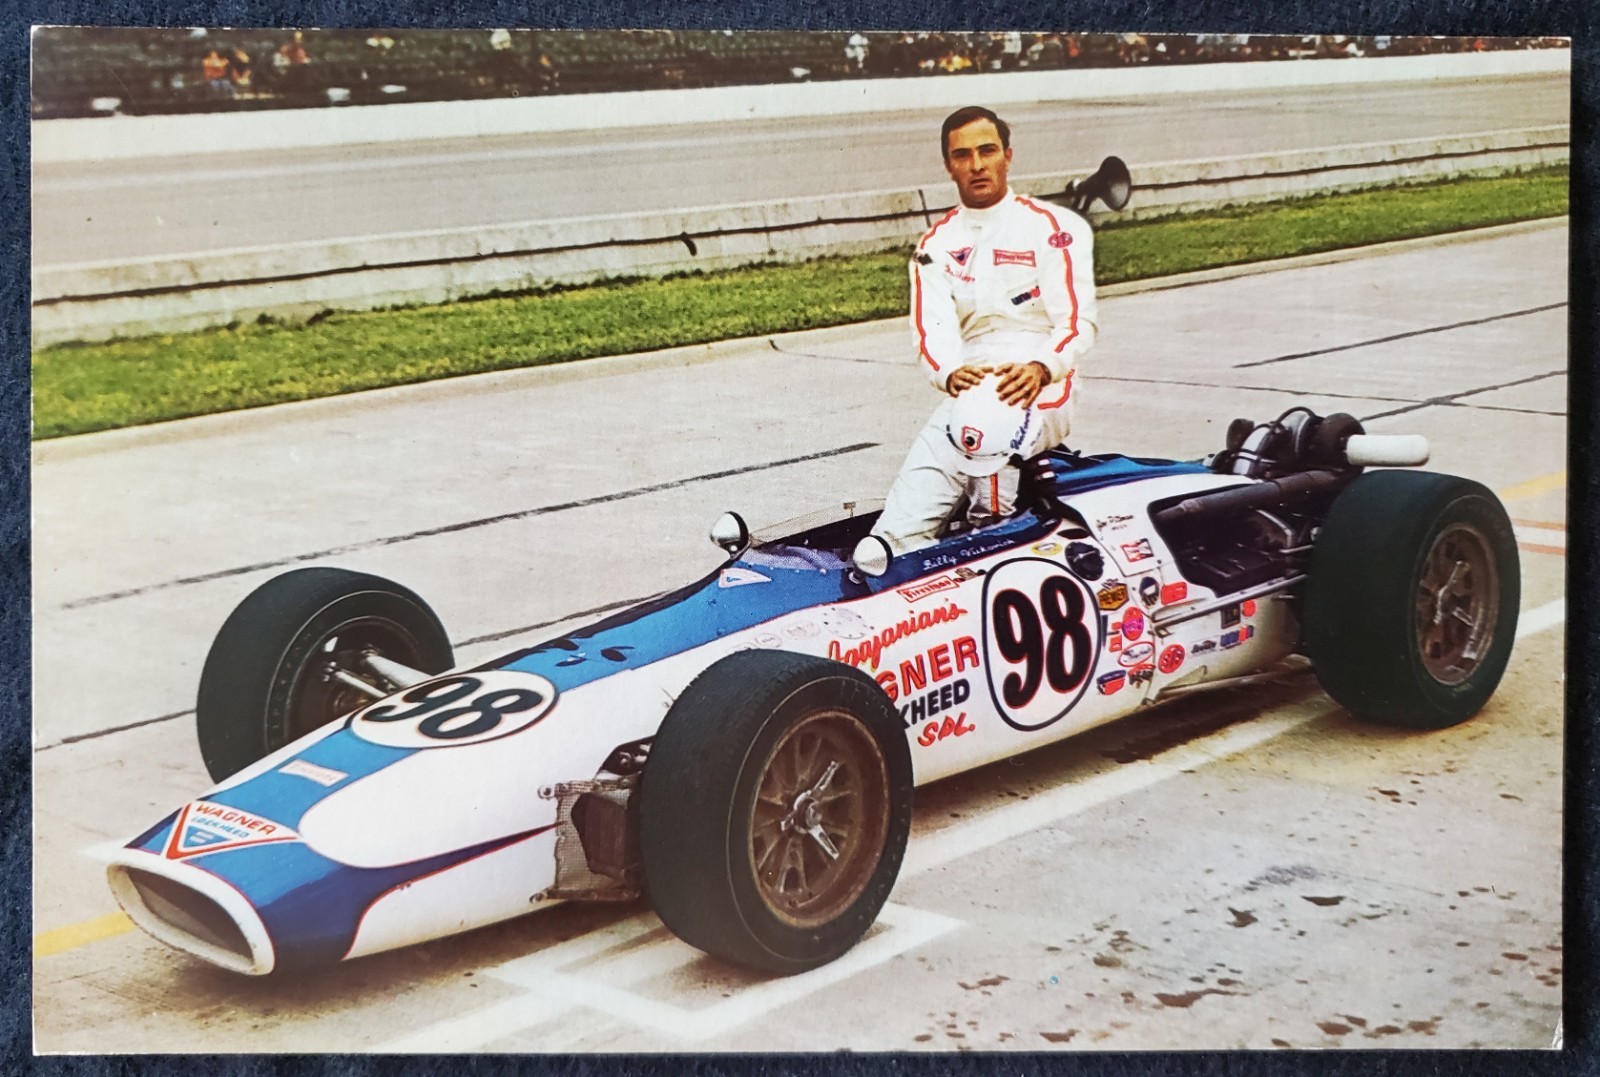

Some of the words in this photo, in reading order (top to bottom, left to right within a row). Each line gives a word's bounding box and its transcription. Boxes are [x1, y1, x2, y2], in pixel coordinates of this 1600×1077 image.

[902, 579, 952, 599] Firestone
[875, 635, 980, 703] GNER
[992, 574, 1093, 710] 98
[361, 676, 544, 740] 98
[899, 678, 971, 730] KHEED
[196, 803, 277, 835] WAGNER
